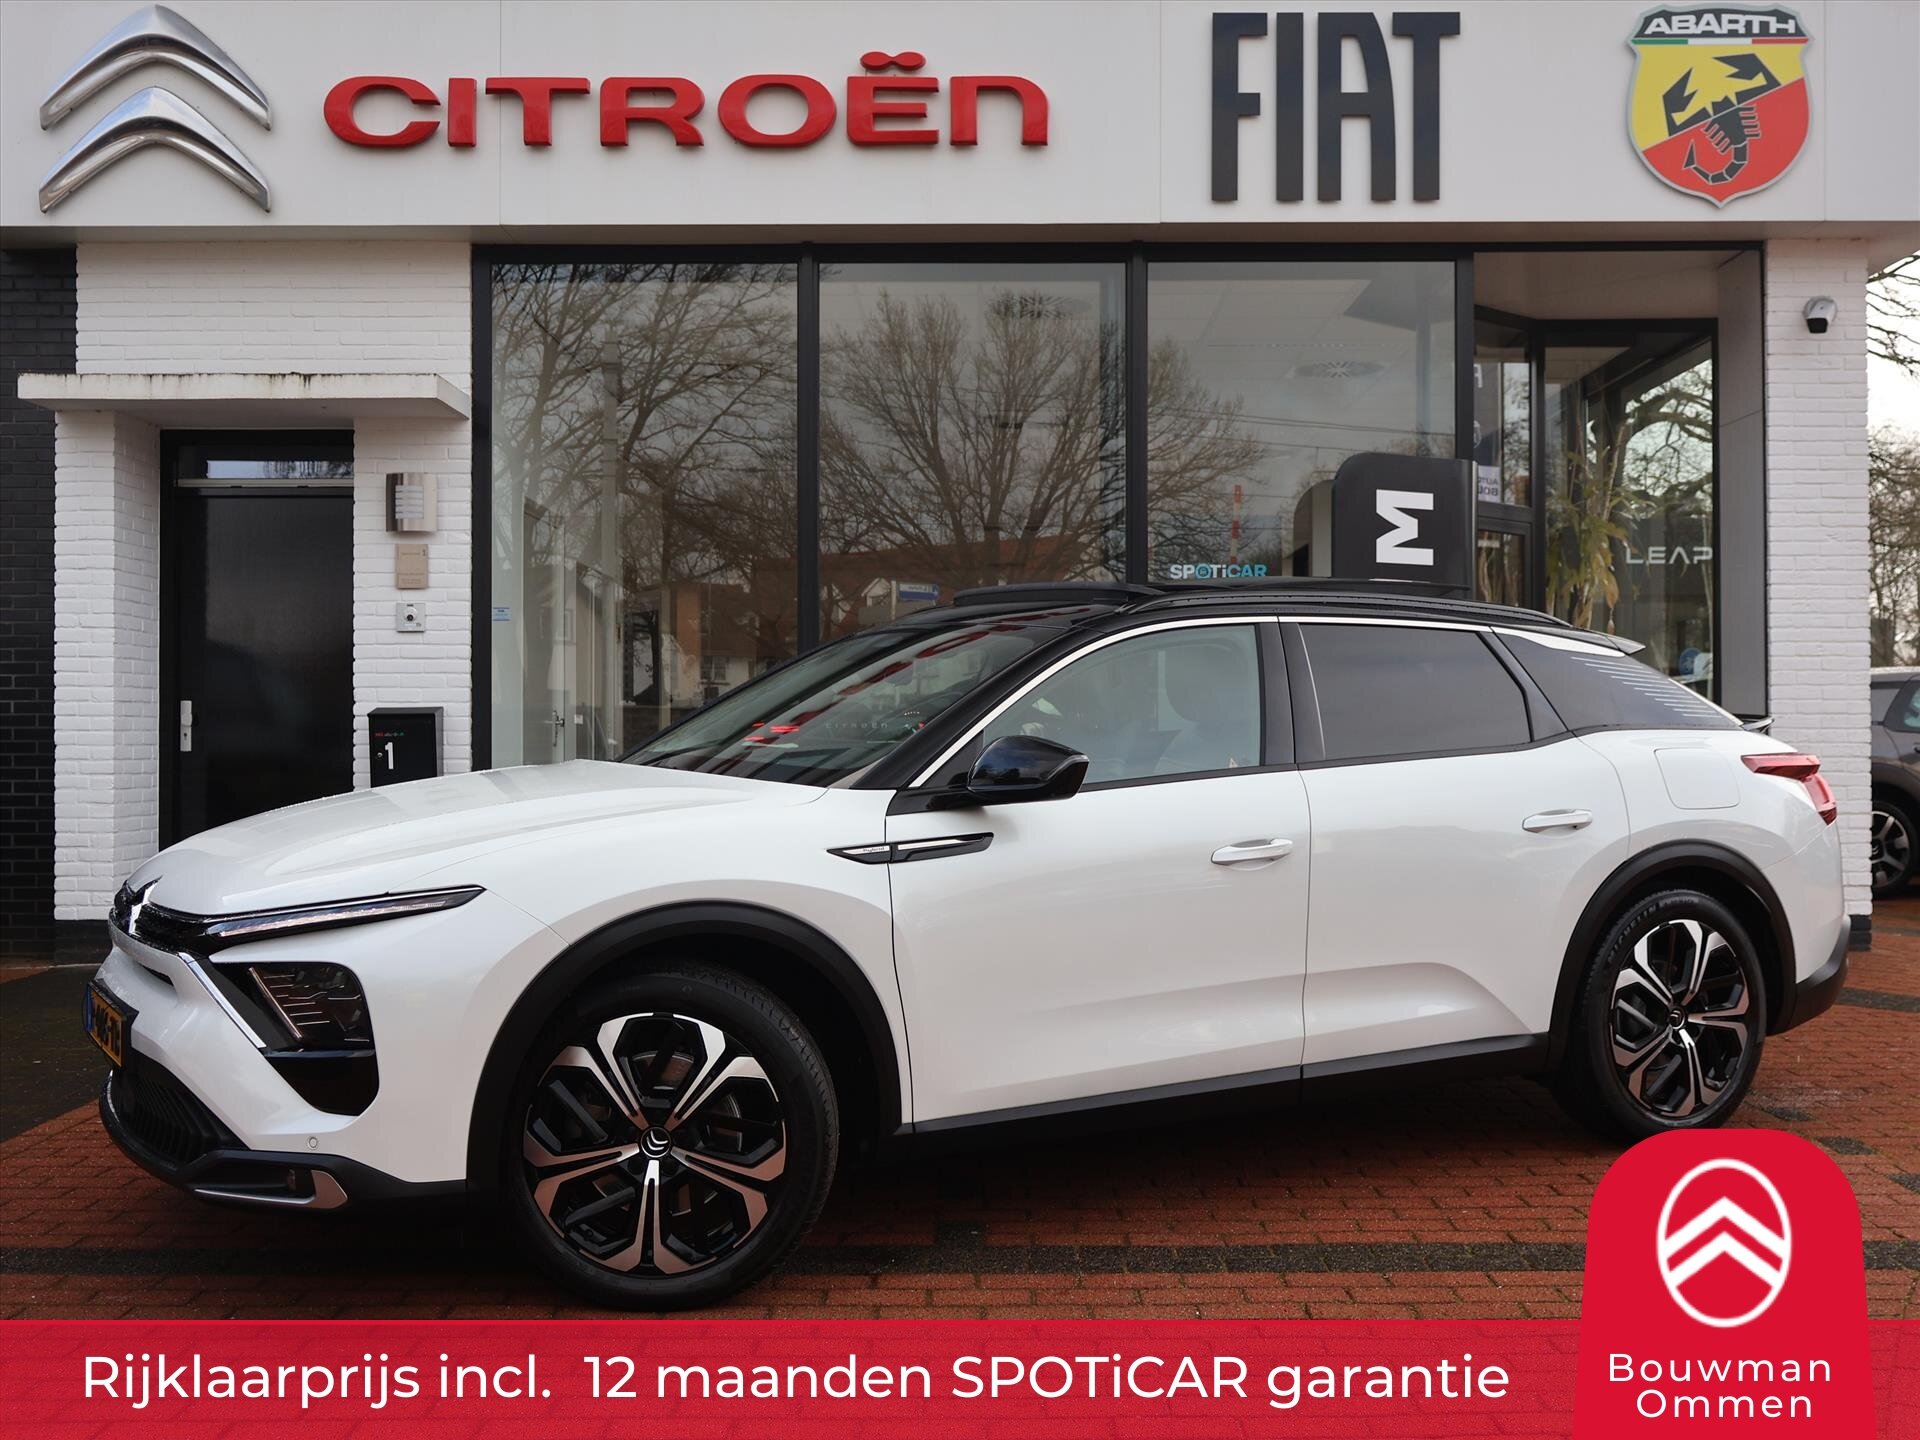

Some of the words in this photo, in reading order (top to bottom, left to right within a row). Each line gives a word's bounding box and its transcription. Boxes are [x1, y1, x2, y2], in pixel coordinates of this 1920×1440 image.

[1644, 13, 1796, 35] ABARTH
[324, 51, 1050, 149] CITROËN
[1212, 12, 1460, 202] FIAT
[1624, 546, 1713, 565] LEAP
[385, 741, 394, 770] 1
